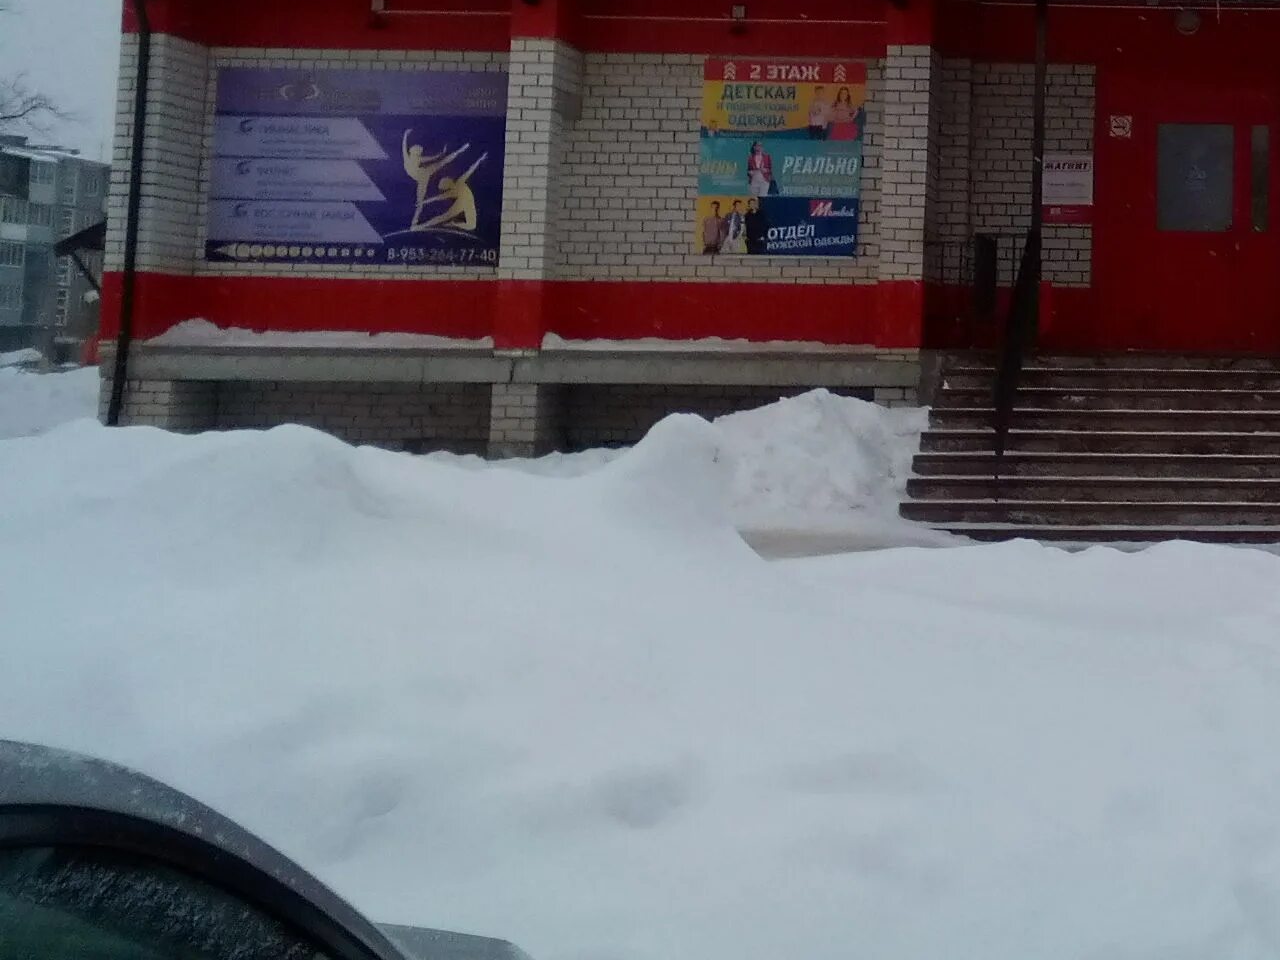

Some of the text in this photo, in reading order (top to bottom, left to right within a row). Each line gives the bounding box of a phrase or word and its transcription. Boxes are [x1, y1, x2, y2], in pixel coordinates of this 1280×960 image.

[749, 64, 821, 81] 2 ЭТАЖ
[721, 84, 797, 101] ДЕТСКАЯ
[728, 114, 786, 128] ОДЕЖДА
[781, 155, 858, 176] РЕАЛЬНО
[767, 224, 816, 241] ОТДЕЛ
[766, 234, 855, 251] МУЖСКОЙ ОДЕЖДЫ
